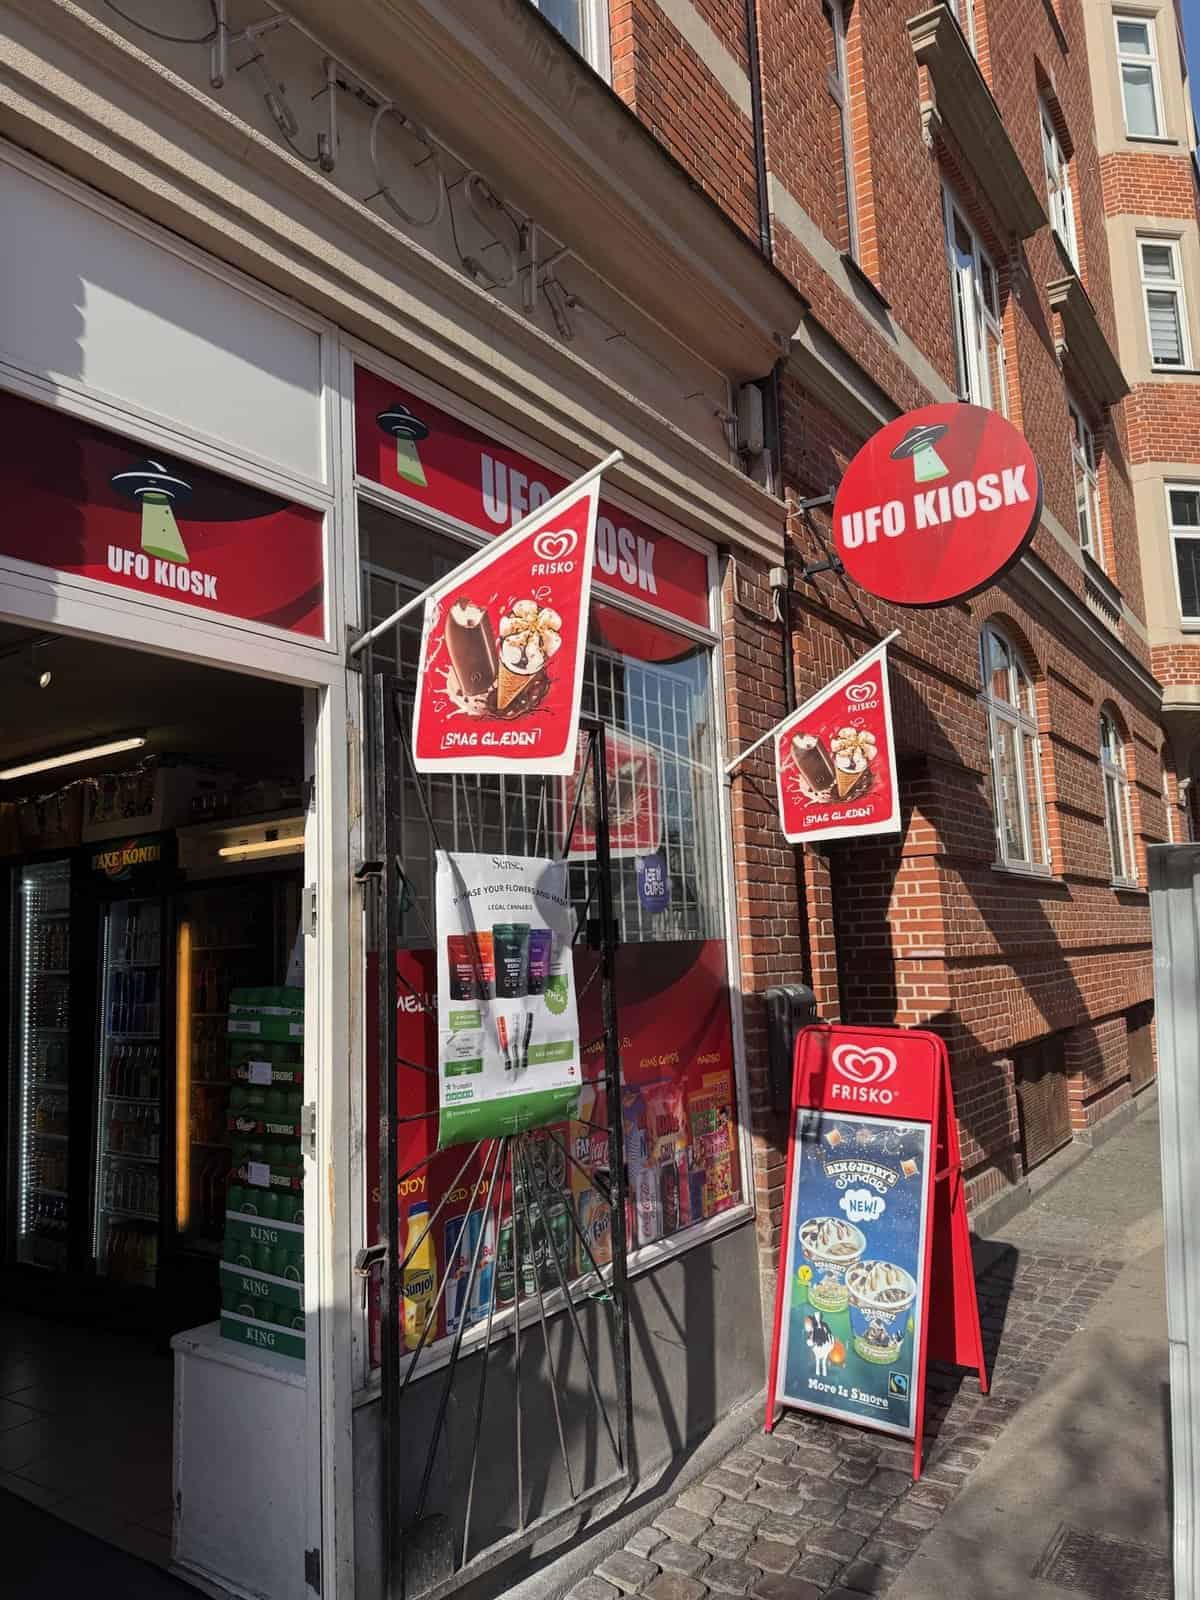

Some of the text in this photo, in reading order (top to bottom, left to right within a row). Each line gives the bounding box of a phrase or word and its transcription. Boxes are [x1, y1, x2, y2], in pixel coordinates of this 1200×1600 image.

[841, 463, 1031, 550] UFO KIOSK
[592, 516, 658, 596] OSK
[107, 545, 218, 600] UFO KIOSK
[531, 560, 574, 576] FRISKO
[847, 702, 878, 713] FRISKO
[446, 731, 538, 746] SMAG GLÆDEN
[484, 884, 504, 895] YOUR
[831, 1084, 893, 1104] FRISKO
[834, 1173, 888, 1194] Sundae
[849, 1199, 878, 1215] NEW!
[250, 1227, 279, 1242] KING
[242, 1278, 270, 1295] KING
[246, 1330, 276, 1346] KING
[808, 1378, 837, 1395] More
